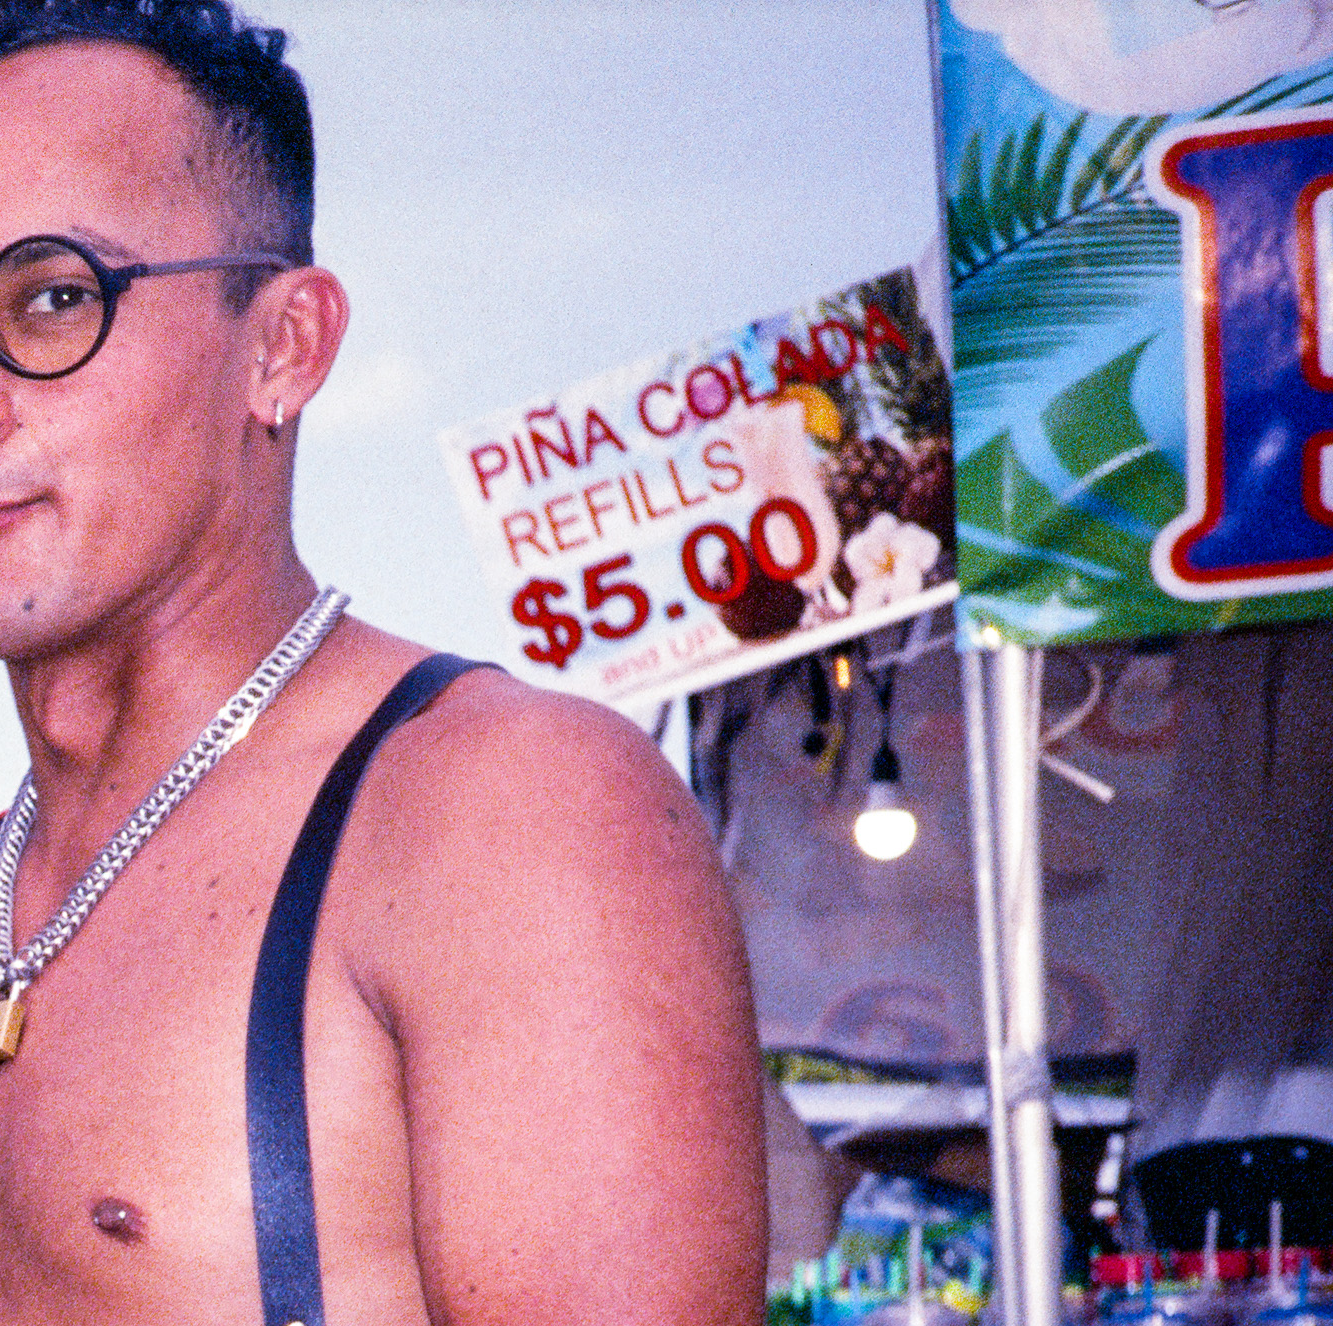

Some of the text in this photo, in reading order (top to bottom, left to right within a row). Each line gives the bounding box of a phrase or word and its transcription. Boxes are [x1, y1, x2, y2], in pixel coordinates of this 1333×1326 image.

[469, 303, 910, 501] PIÑA COLADA
[500, 439, 746, 567] REFILLS
[511, 497, 819, 670] $5.00
